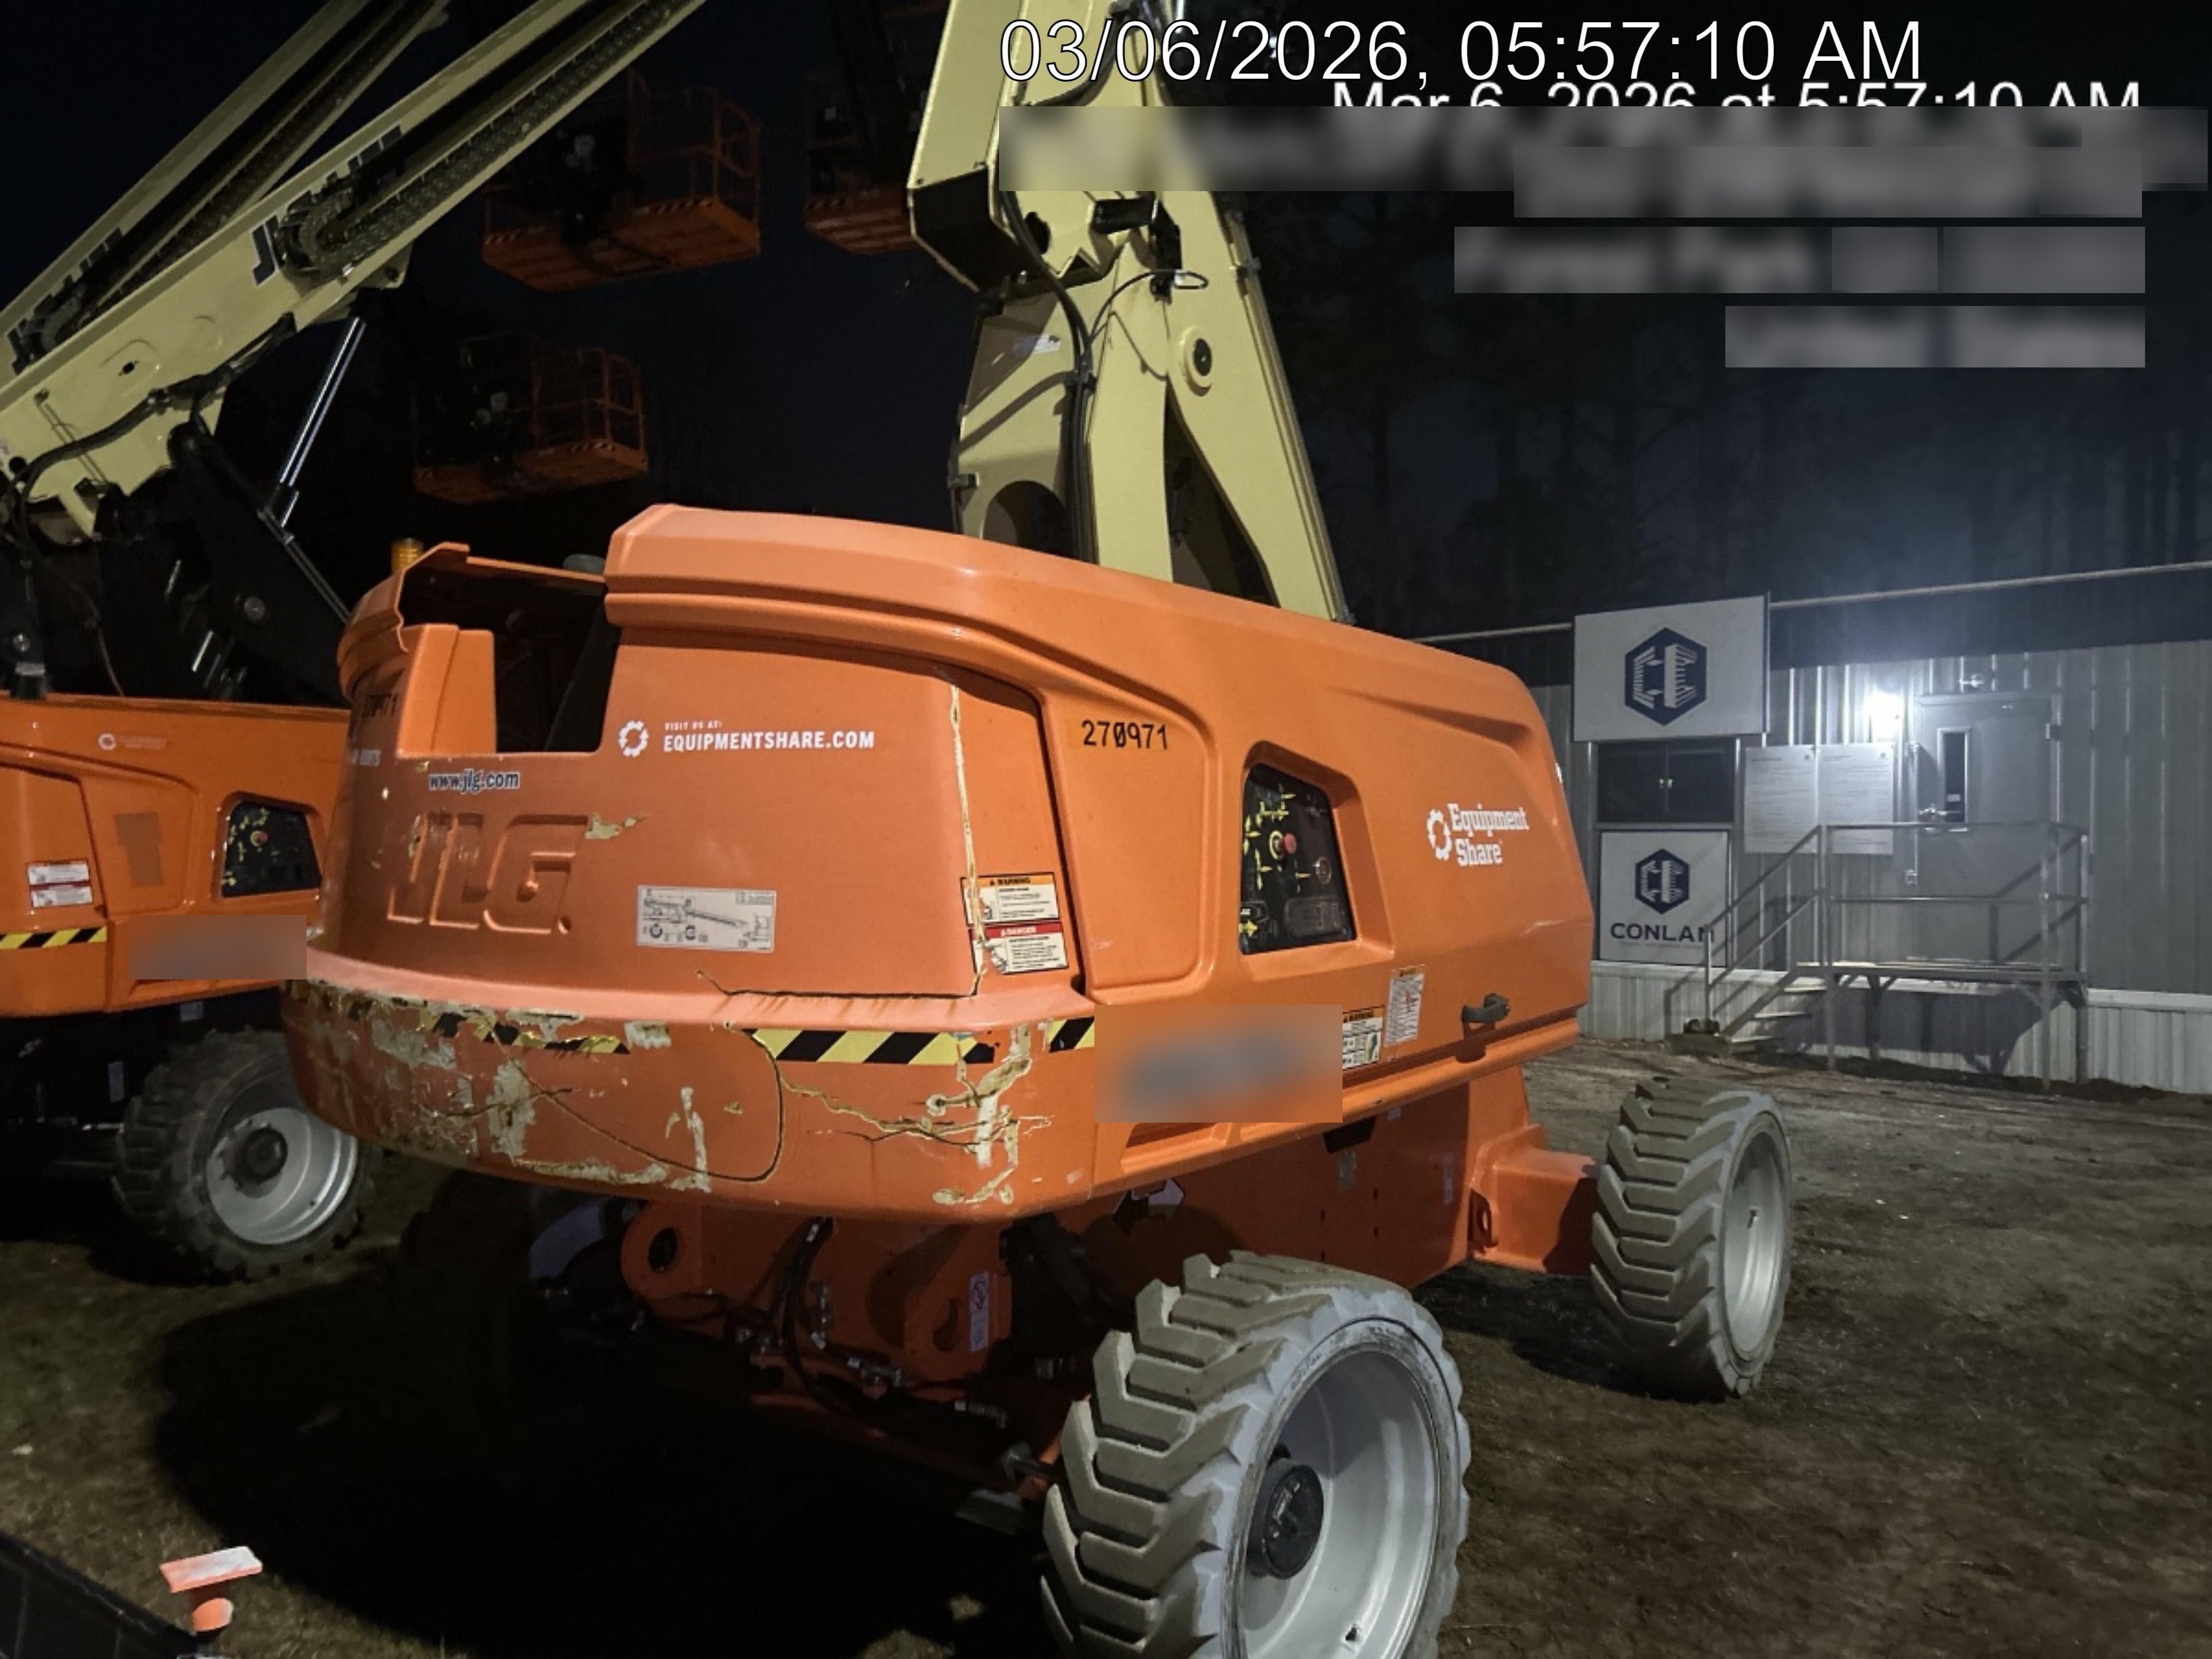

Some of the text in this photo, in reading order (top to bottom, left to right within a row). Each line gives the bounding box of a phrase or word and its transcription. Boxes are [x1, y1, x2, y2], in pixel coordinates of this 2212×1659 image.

[664, 731, 874, 752] EQUIPMENTSHARE.COM
[1081, 720, 1167, 750] 270971
[429, 768, 520, 794] www.jlg.com
[1448, 803, 1530, 837] Equipment
[1456, 838, 1503, 866] Share
